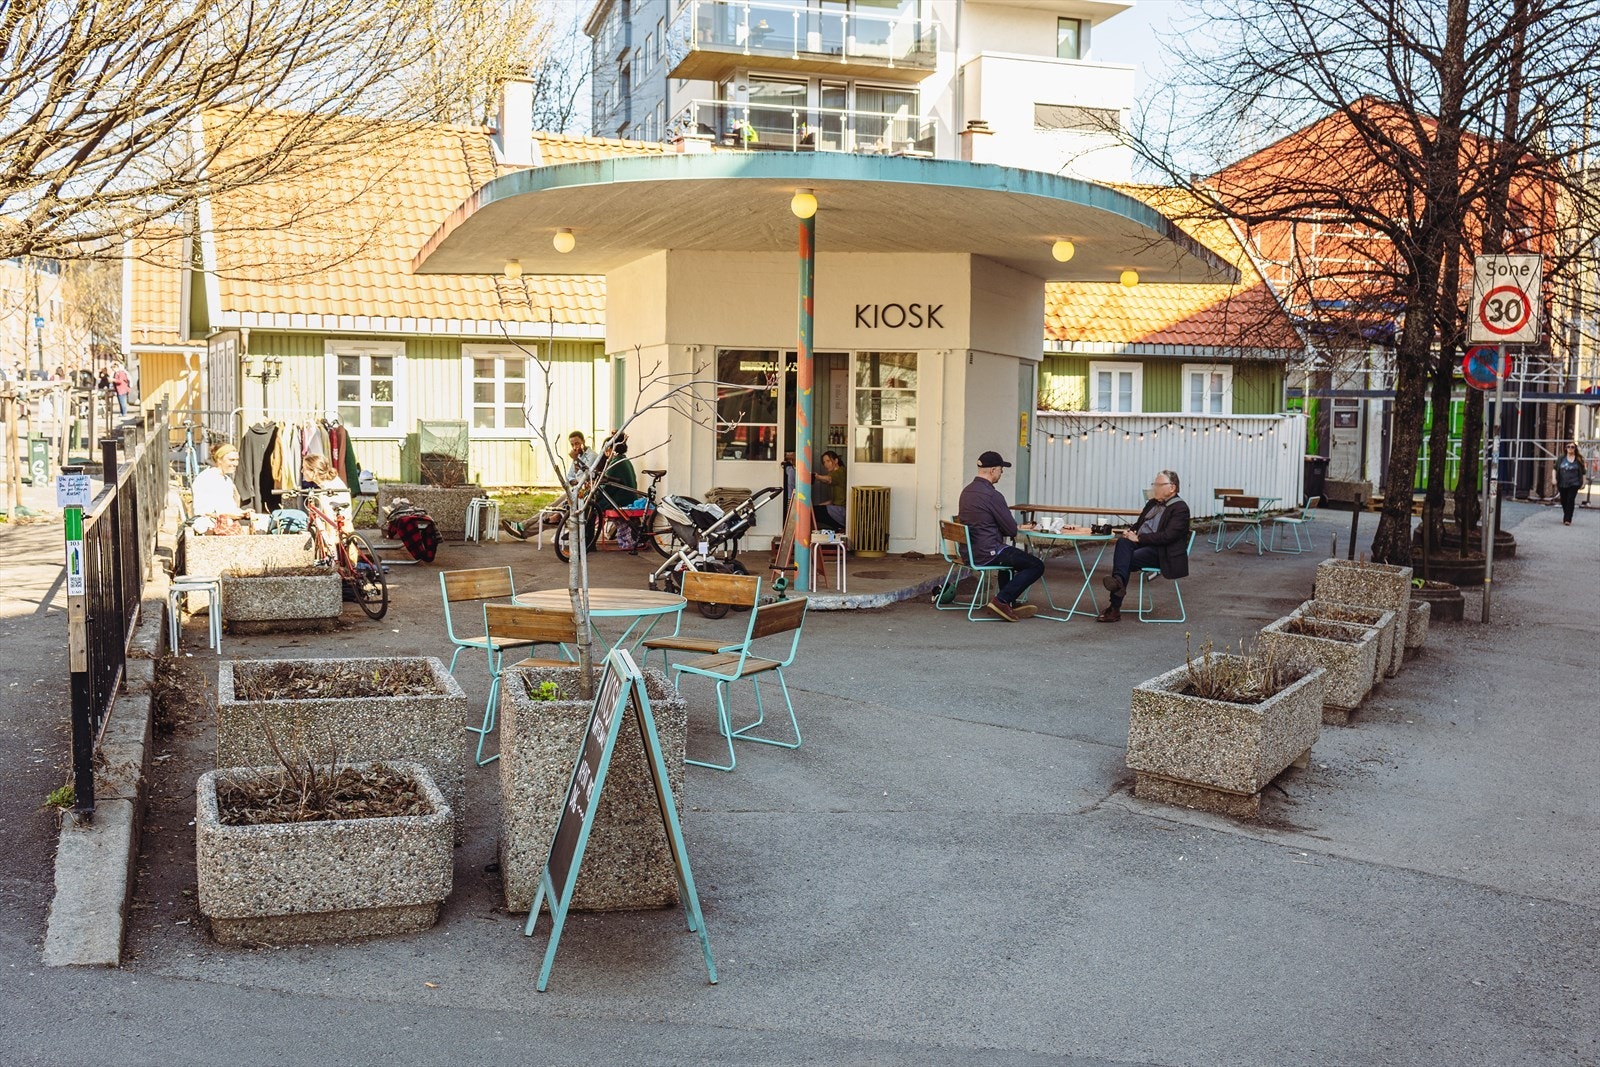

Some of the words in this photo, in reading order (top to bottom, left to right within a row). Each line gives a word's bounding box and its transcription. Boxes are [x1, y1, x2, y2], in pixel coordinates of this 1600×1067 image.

[1485, 261, 1530, 276] Sone
[855, 303, 944, 329] KIOSK
[1488, 298, 1522, 323] 30
